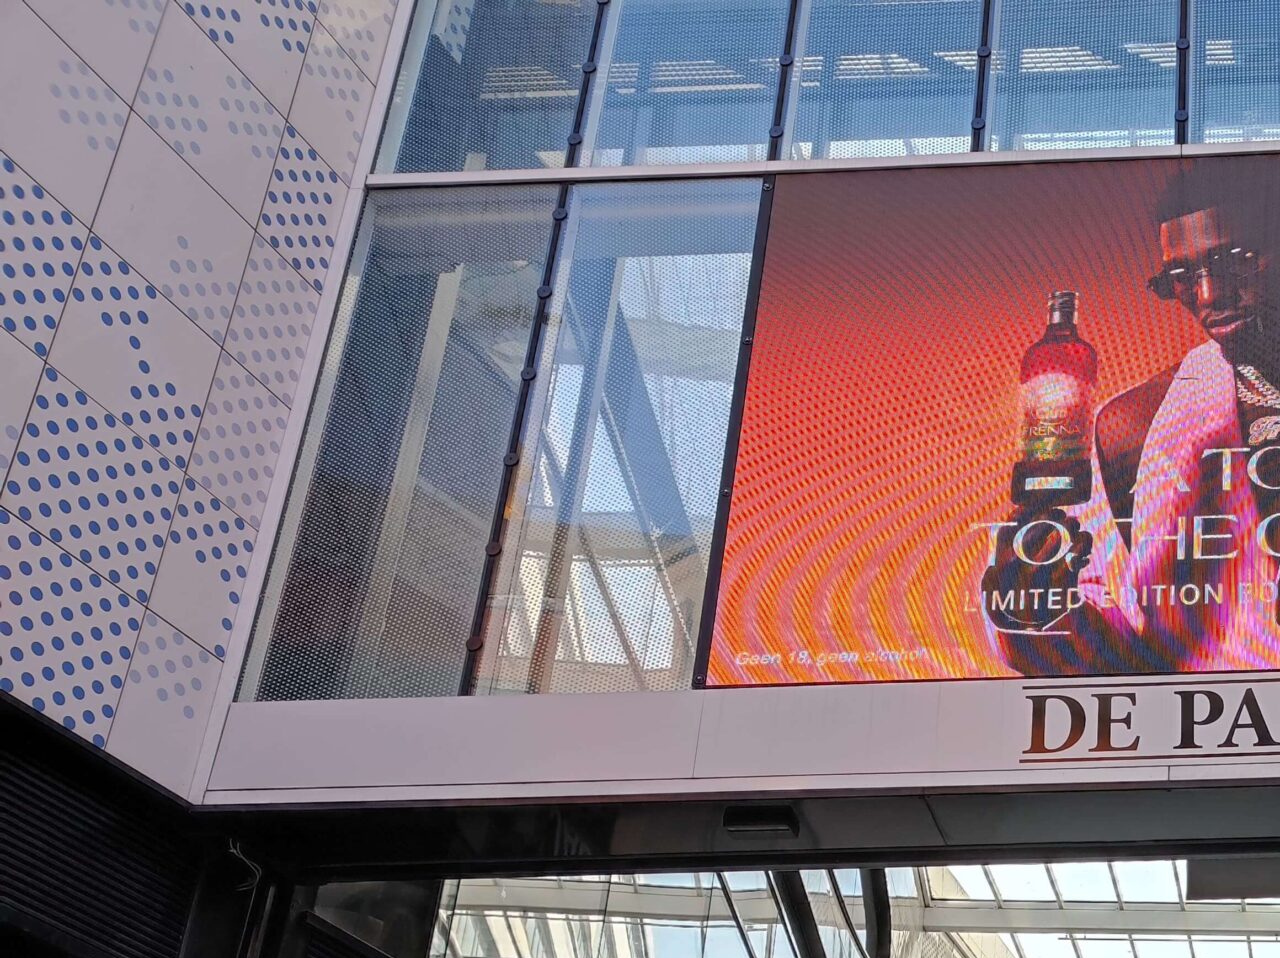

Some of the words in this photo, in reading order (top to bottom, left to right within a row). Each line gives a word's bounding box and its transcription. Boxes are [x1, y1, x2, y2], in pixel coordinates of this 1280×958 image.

[970, 519, 1073, 569] TO
[964, 587, 1086, 612] LIMITED
[1100, 582, 1224, 608] EDITION
[1022, 691, 1141, 755] DE
